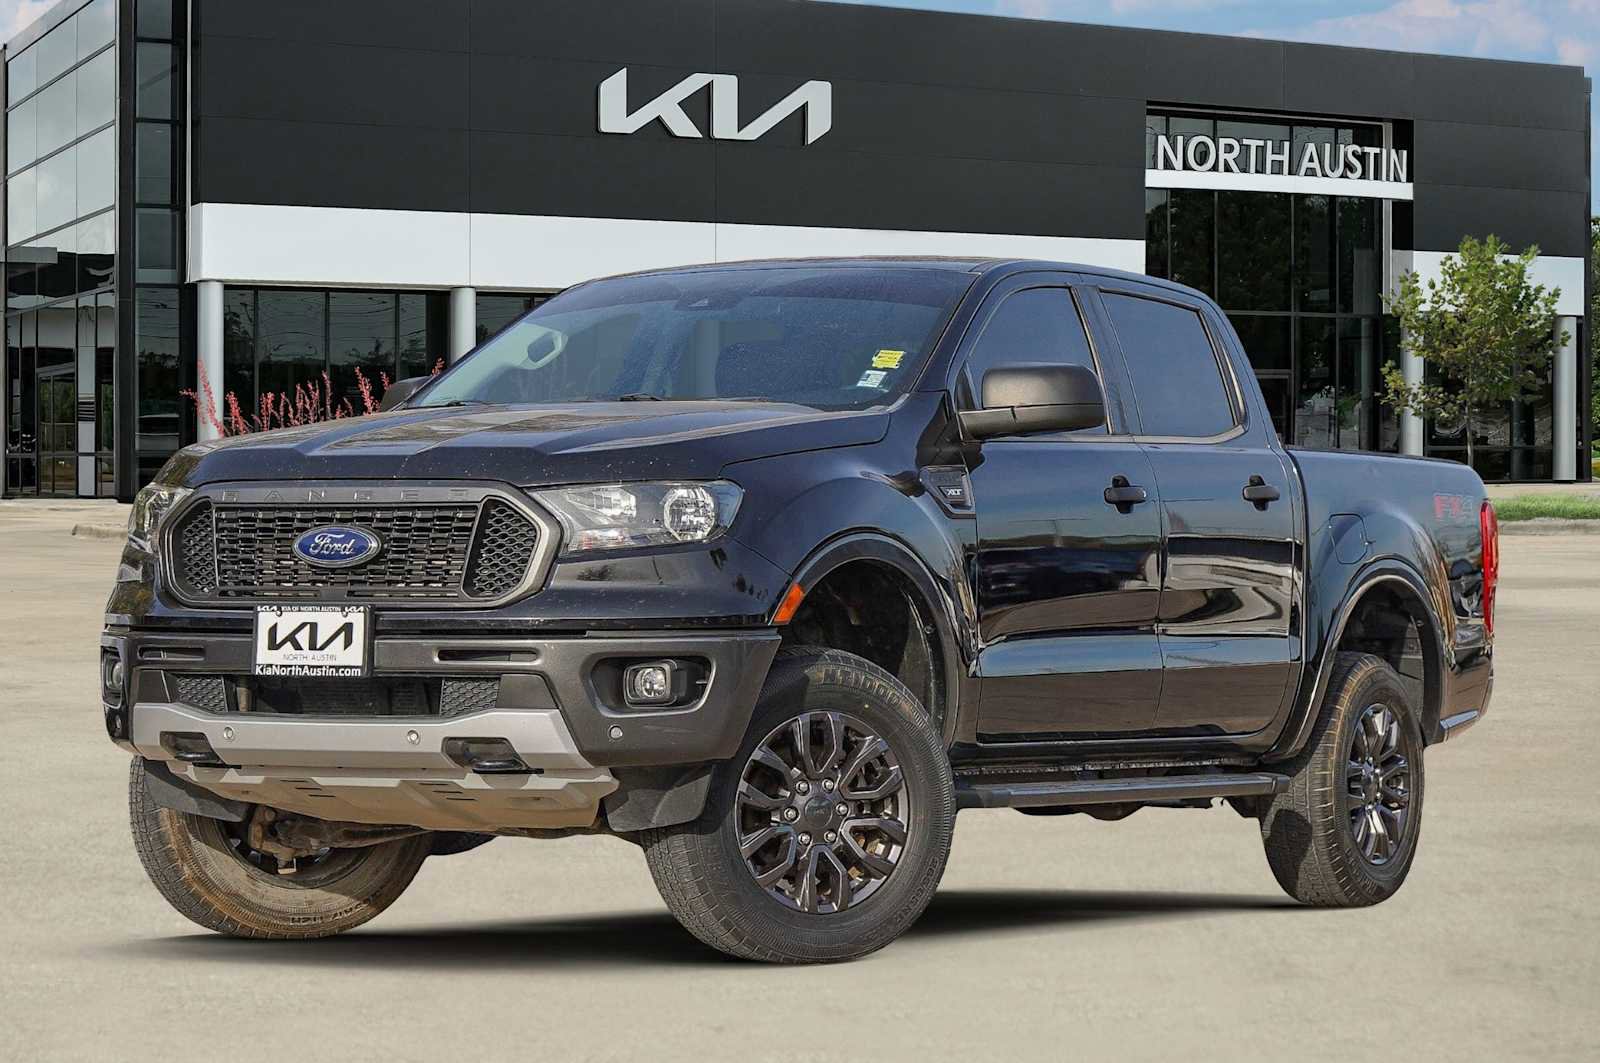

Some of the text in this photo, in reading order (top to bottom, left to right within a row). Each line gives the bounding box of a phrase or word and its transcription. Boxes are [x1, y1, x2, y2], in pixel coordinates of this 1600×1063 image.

[599, 67, 832, 145] KIA
[1157, 134, 1408, 183] NORTH AUSTIN
[309, 532, 355, 556] Ford
[267, 622, 354, 651] KIA
[255, 664, 361, 677] KiaNorthAustin.com
